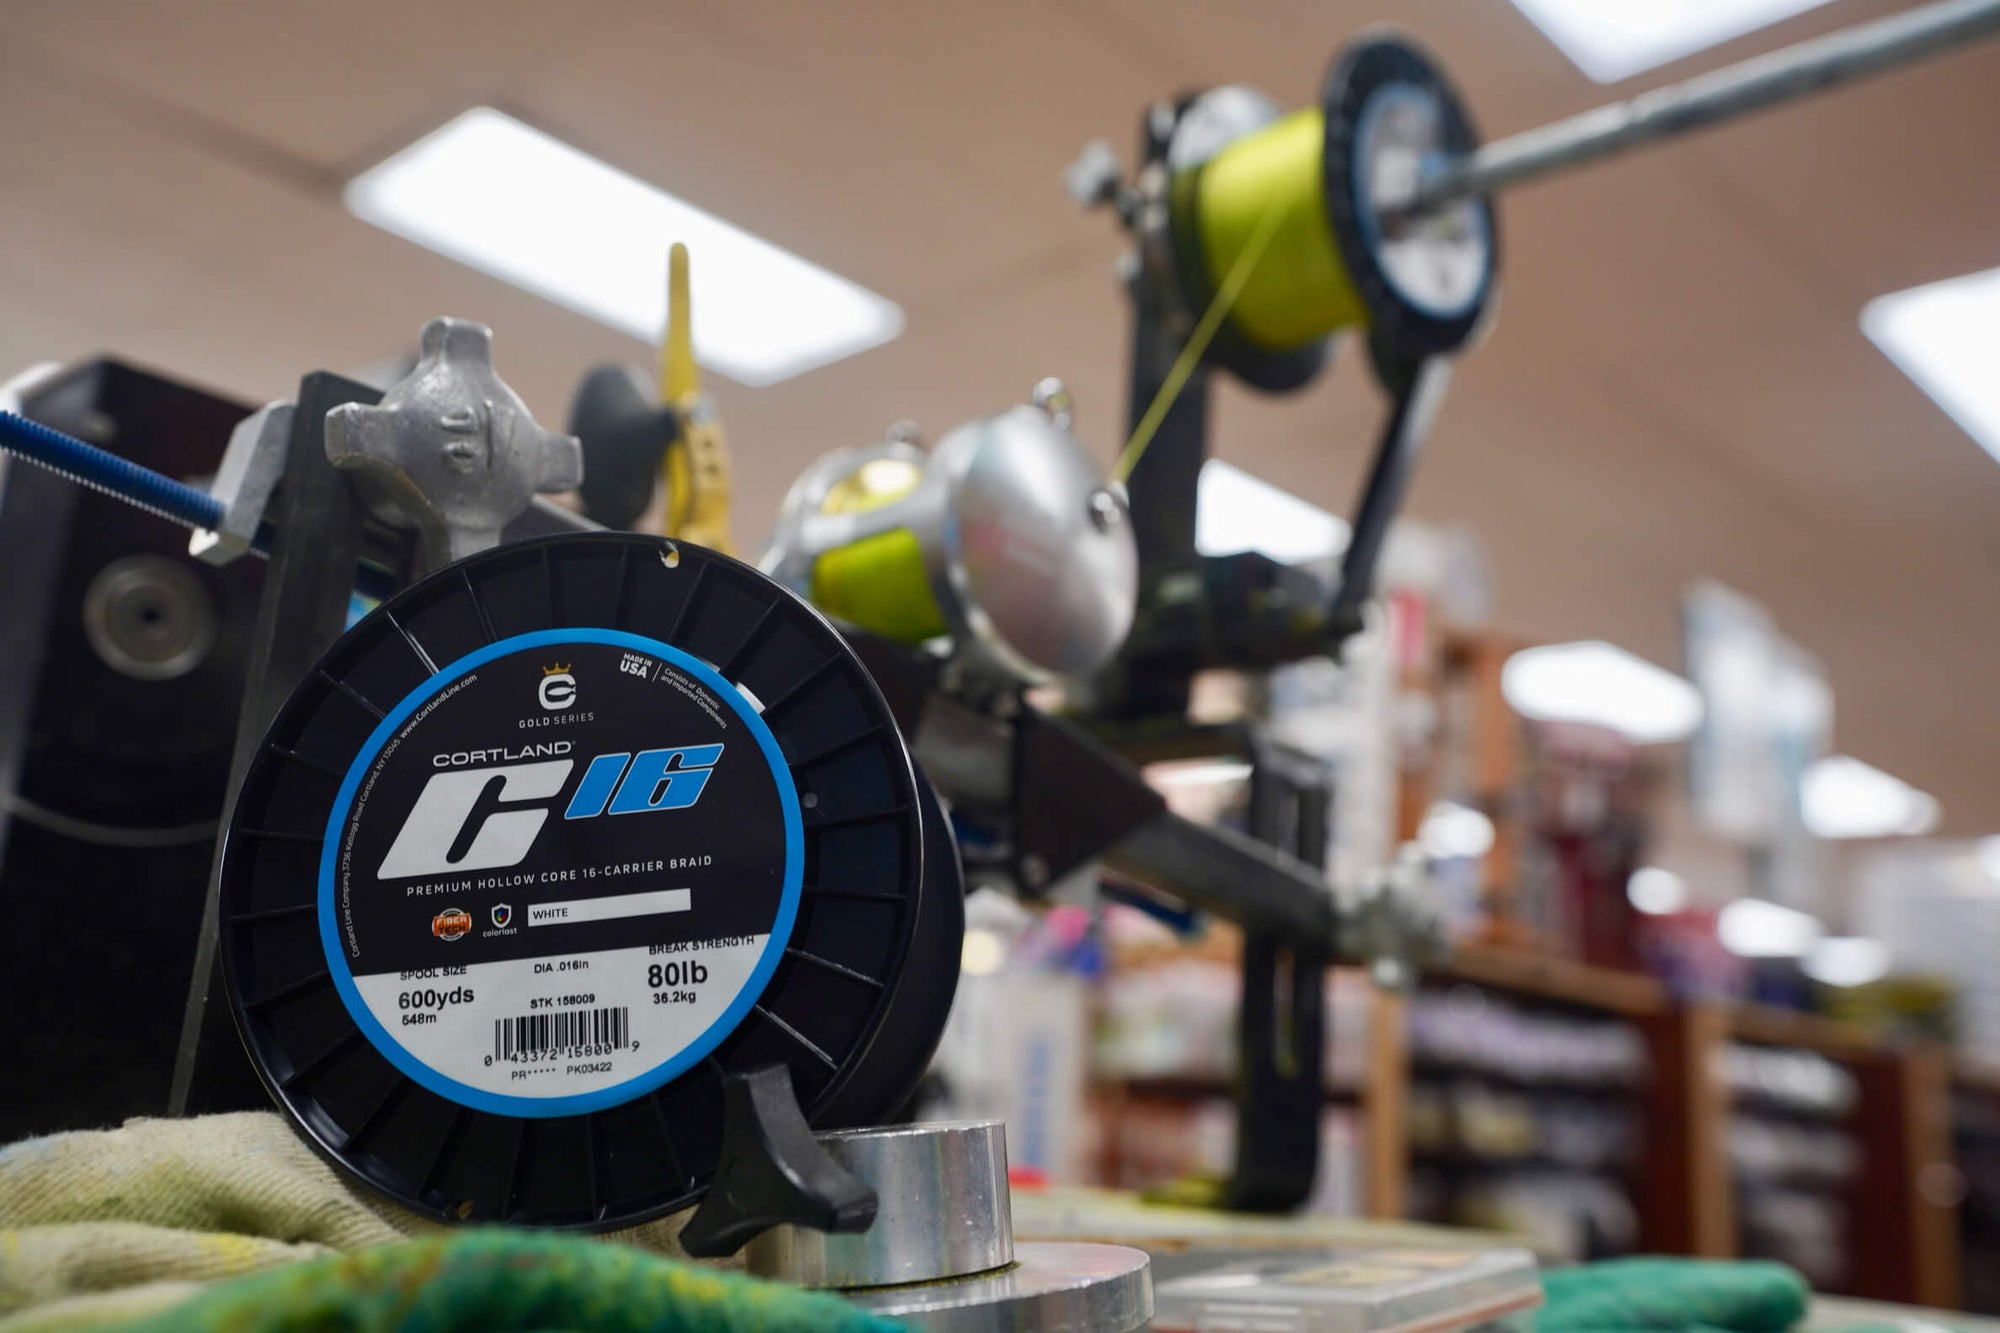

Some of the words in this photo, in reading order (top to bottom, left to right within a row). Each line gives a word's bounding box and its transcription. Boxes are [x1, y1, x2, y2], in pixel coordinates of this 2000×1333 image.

[620, 660, 647, 679] USA
[623, 653, 644, 663] MADE
[643, 659, 653, 667] IN
[664, 668, 689, 686] Consists
[695, 687, 720, 711] Domestic
[400, 673, 478, 740] www.CortlandLine.com
[661, 675, 674, 685] and
[672, 681, 698, 702] Imported
[696, 698, 727, 729] Components
[518, 717, 551, 729] GOLD
[553, 712, 595, 725] SERIES
[382, 738, 401, 760] 13045
[432, 740, 573, 768] CORTLAND
[375, 757, 387, 772] NY
[352, 801, 366, 822] Road
[344, 821, 360, 851] Kellogg
[341, 851, 352, 871] 3736
[406, 880, 472, 897] PREMIUM
[477, 873, 536, 890] HOLLOW
[540, 869, 577, 883] CORE
[581, 860, 664, 879] 16-CARRIER
[669, 855, 713, 869] BRAID
[342, 871, 351, 909] Company
[344, 907, 353, 926] Line
[436, 914, 467, 926] FIBER
[532, 907, 569, 921] WHITE
[437, 925, 466, 936] TECH
[649, 942, 689, 956] BREAK
[691, 935, 755, 952] STRENGTH
[399, 967, 440, 981] SPOOL
[442, 963, 467, 977] SIZE
[533, 963, 554, 974] DIA
[556, 960, 589, 972] .016in
[647, 960, 708, 989] 80lb
[398, 986, 475, 1012] 600yds
[530, 998, 553, 1010] STK
[556, 993, 596, 1006] 158009
[652, 990, 697, 1005] 36.2kg
[401, 1013, 438, 1026] 548m
[484, 1055, 493, 1067] 0
[510, 1049, 558, 1064] 43372
[567, 1042, 613, 1059] 15800
[631, 1040, 640, 1053] 9
[566, 1062, 613, 1075] PK03422
